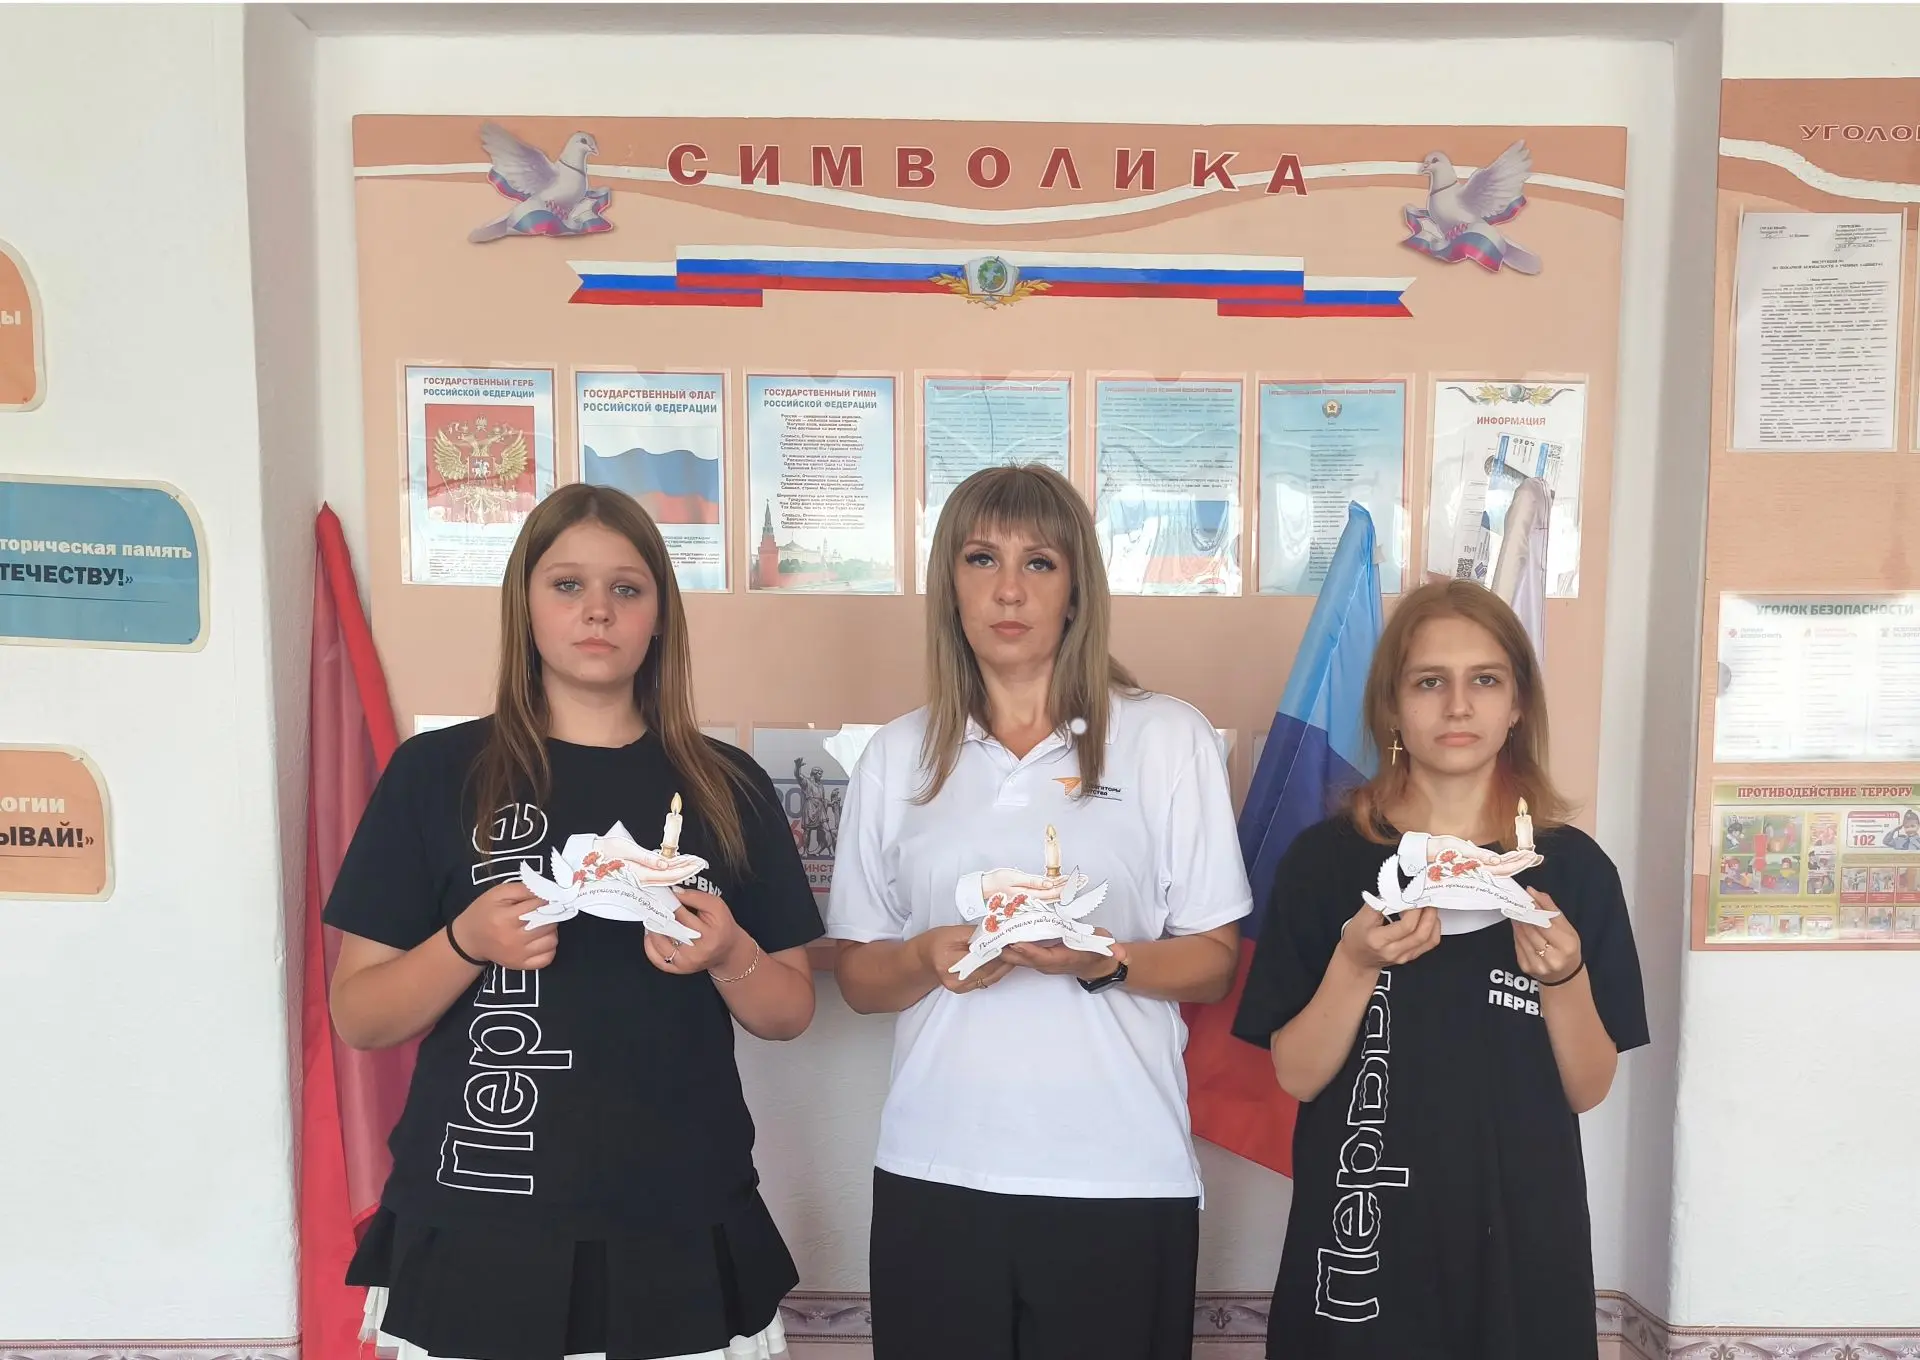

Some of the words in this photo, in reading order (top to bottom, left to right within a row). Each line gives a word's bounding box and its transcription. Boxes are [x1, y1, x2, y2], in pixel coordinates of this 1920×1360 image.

[1799, 124, 1920, 142] УГОЛО
[667, 143, 1308, 196] СИМВОЛИКА
[424, 376, 509, 387] ГОСУДАРСТВЕННЫЙ
[512, 378, 534, 387] ГЕРБ
[423, 387, 478, 398] РОССИЙСКОЙ
[482, 388, 535, 399] ФЕДЕРАЦИИ
[584, 388, 686, 400] ГОСУДАРСТВЕННЫЙ
[689, 391, 717, 401] ФЛАГ
[764, 388, 850, 397] ГОСУДАРСТВЕННЫЙ
[583, 401, 651, 413] РОССИЙСКОЙ
[655, 402, 718, 414] ФЕДЕРАЦИИ
[764, 399, 822, 408] РОССИЙСКОЙ
[825, 401, 877, 409] ФЕДЕРАЦИИ
[1477, 417, 1546, 425] ИНФОРМАЦИЯ
[122, 544, 192, 559] память
[1757, 604, 1808, 615] УГОЛОК
[1810, 604, 1914, 615] БЕЗОПАСНОСТИ
[1738, 785, 1856, 798] ПРОТИВОДЕЙСТВИЕ
[1861, 787, 1912, 797] ТЕРРОРУ
[0, 796, 65, 813] огии
[1853, 834, 1876, 846] 102
[805, 863, 834, 872] ИНСТ
[1489, 968, 1539, 994] СБОР
[437, 802, 573, 1196] Перве
[1488, 989, 1544, 1018] ПЕРВ
